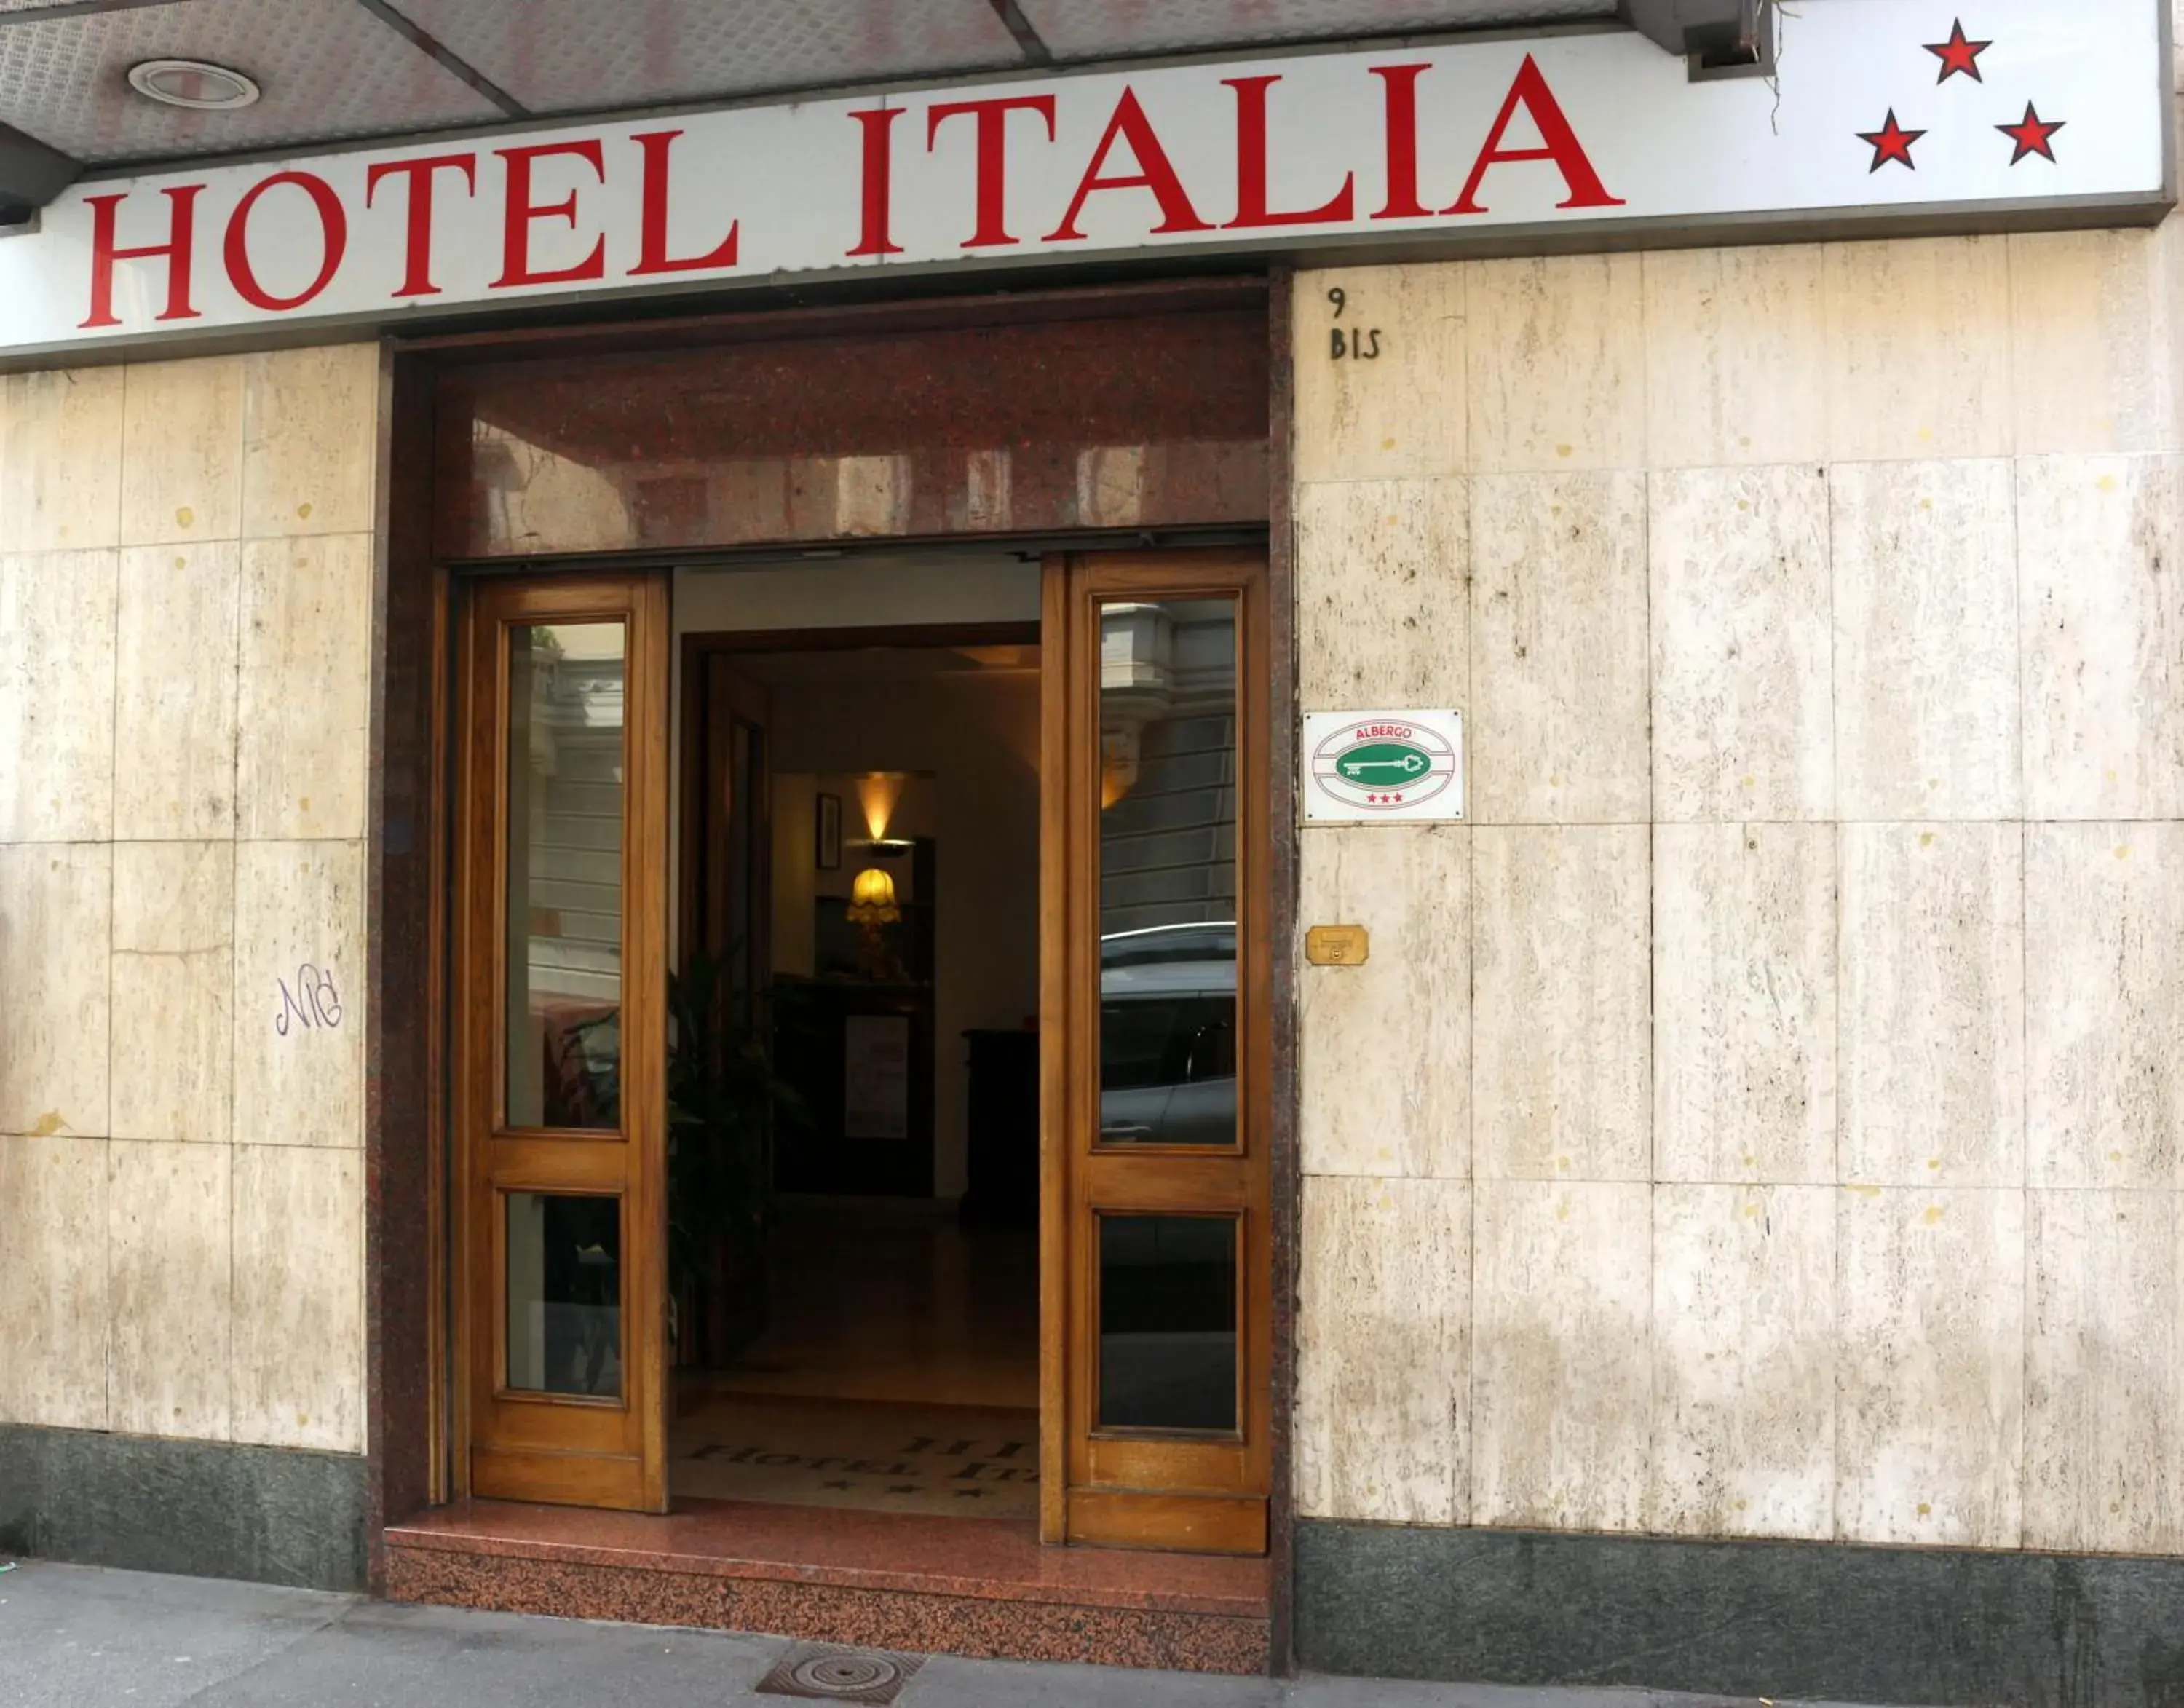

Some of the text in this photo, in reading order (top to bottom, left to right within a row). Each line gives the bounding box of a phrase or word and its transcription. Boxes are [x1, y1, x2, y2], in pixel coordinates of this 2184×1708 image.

[78, 52, 1626, 328] HOTEL ITALIA
[1328, 287, 1346, 320] 9
[1331, 328, 1382, 360] BIS
[1356, 726, 1412, 740] ALBERGO
